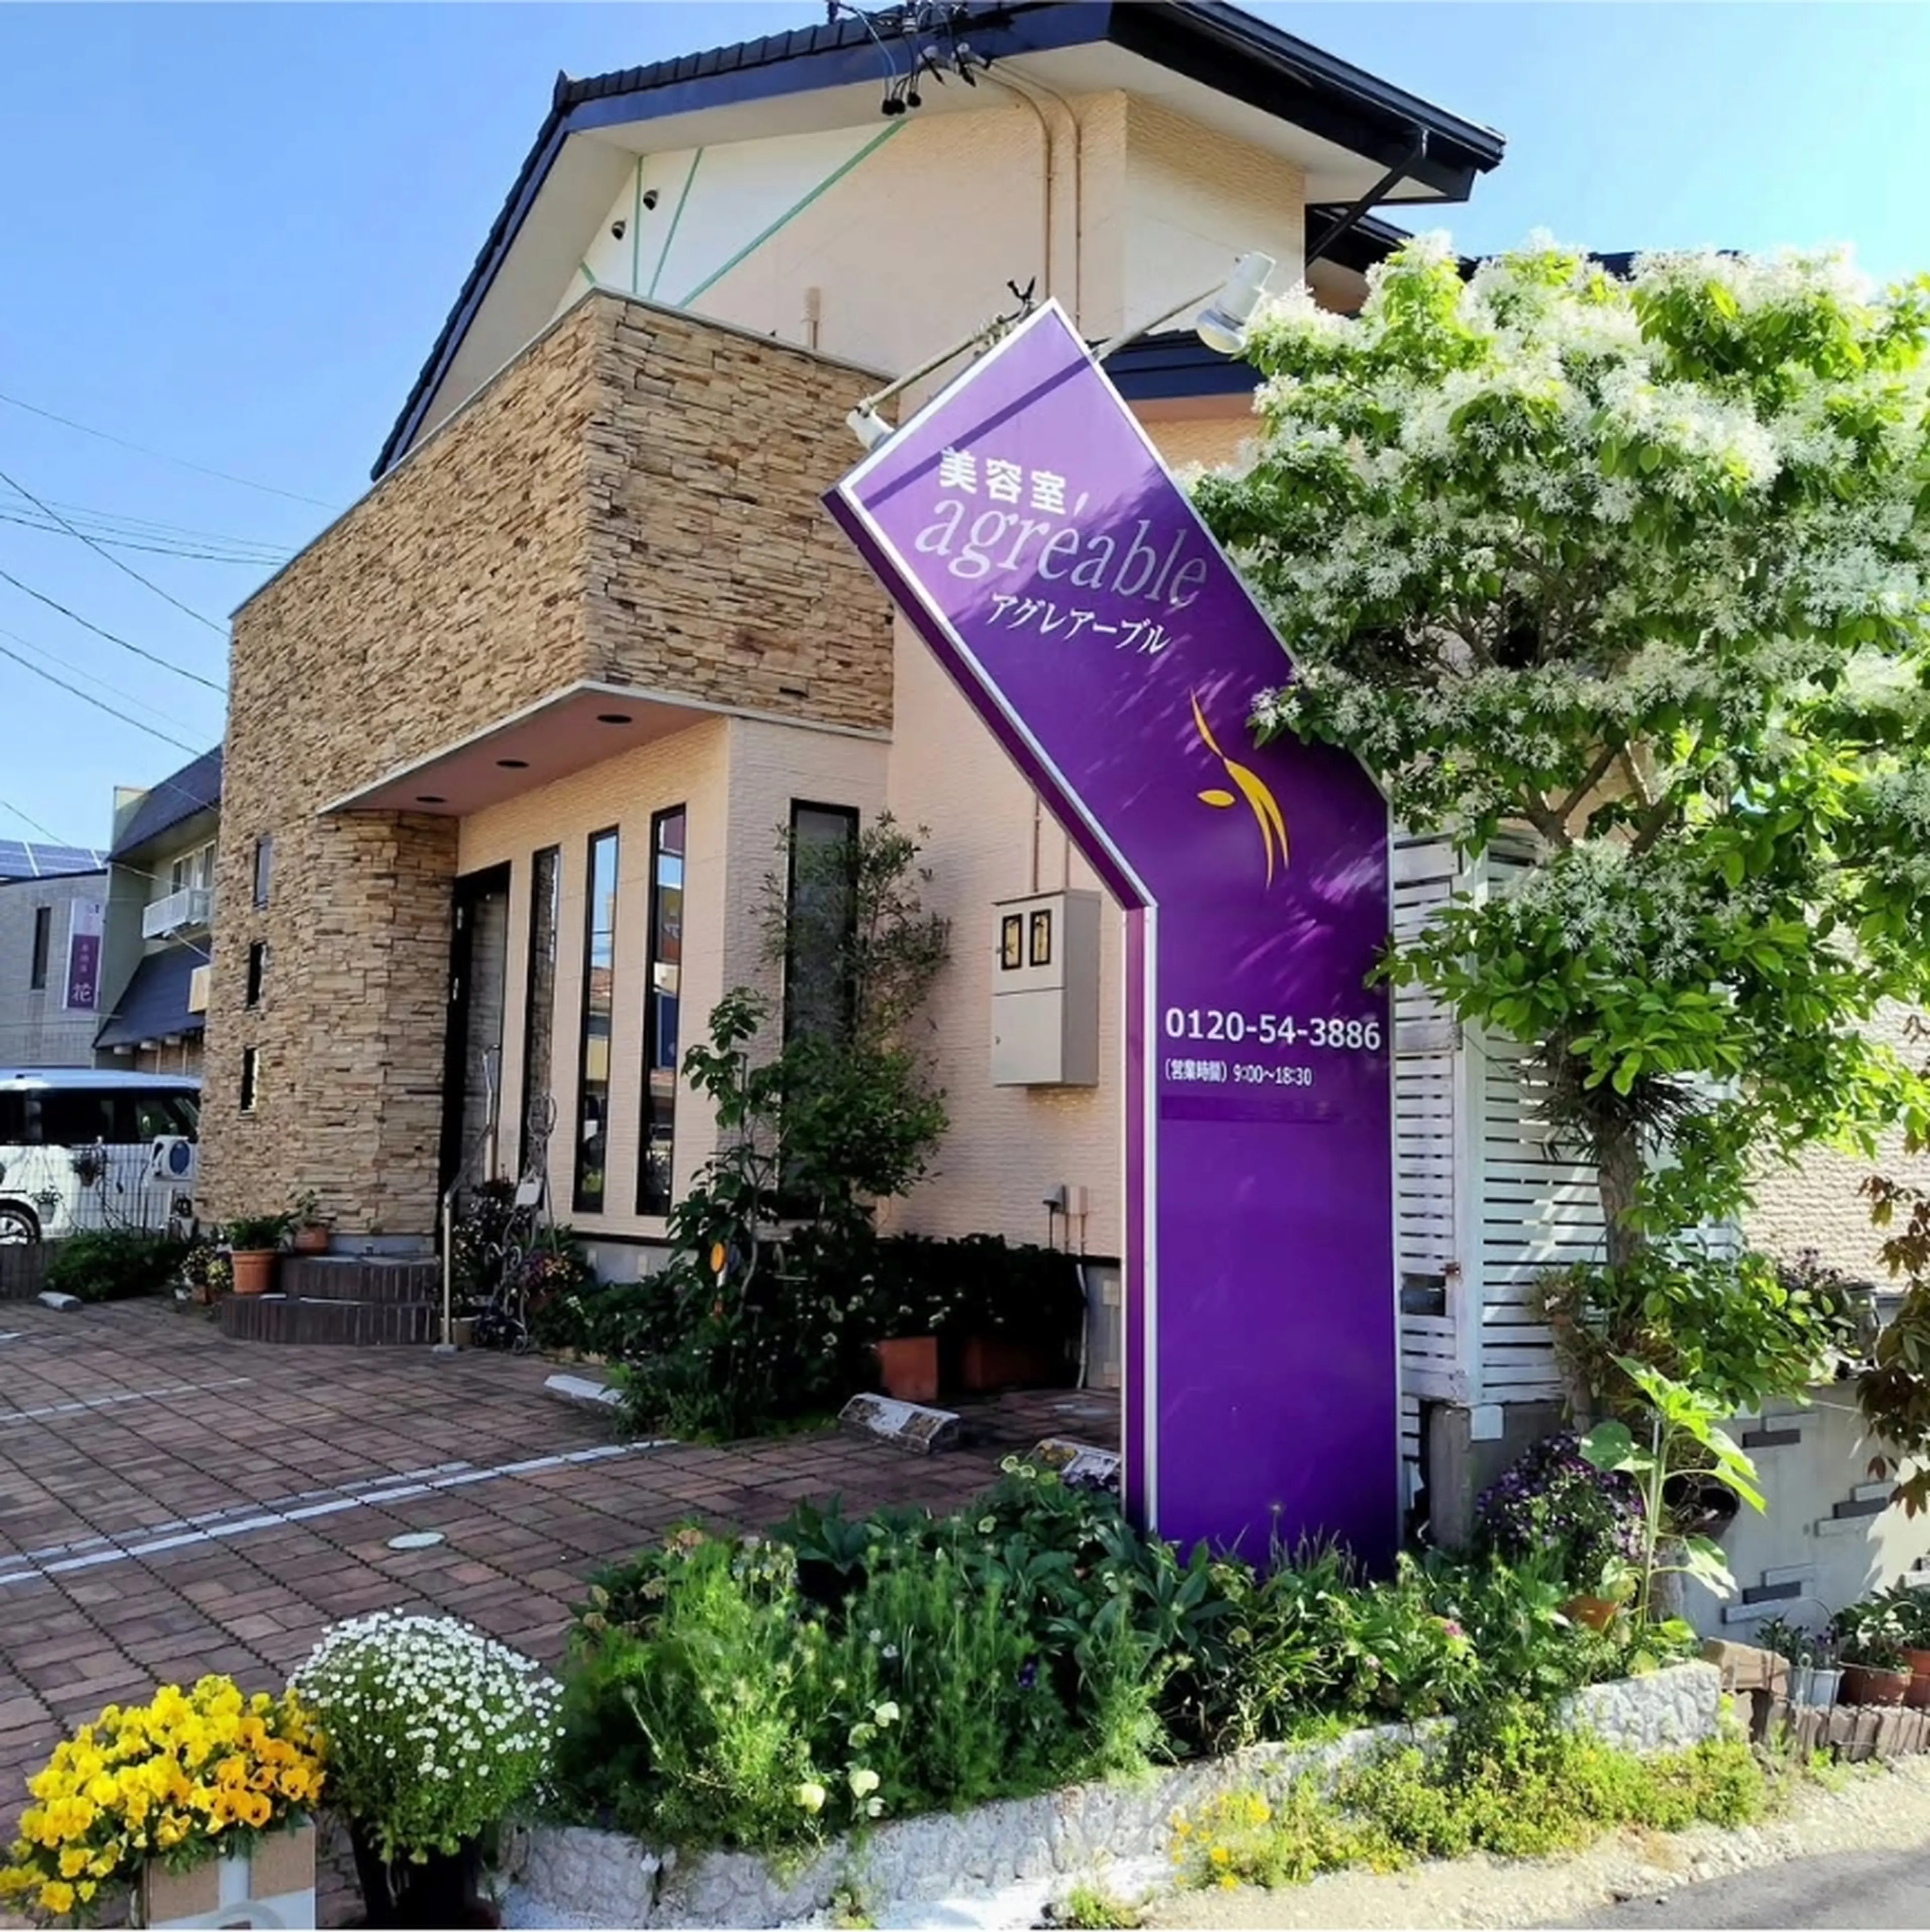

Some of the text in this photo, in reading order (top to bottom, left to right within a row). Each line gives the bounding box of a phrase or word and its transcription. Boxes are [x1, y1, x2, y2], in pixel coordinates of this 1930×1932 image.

[939, 446, 1066, 515] 美容室
[988, 592, 1172, 655] アグレアーブル
[1166, 1007, 1381, 1050] 0120-54-3886
